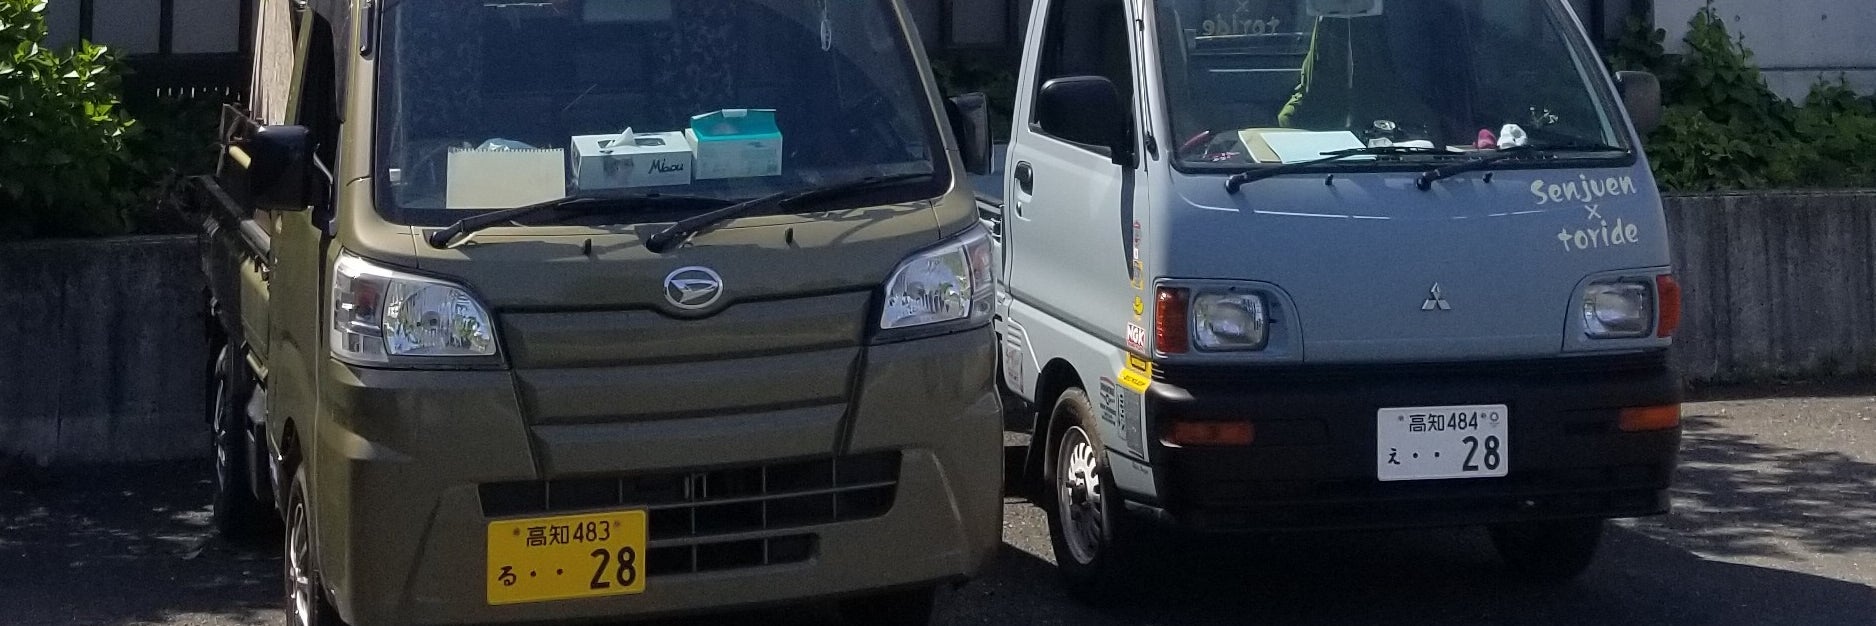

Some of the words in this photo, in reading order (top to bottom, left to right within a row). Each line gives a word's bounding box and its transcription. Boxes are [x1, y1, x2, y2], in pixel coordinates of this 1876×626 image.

[1530, 174, 1637, 205] Senjuen
[1558, 218, 1639, 251] toride
[1126, 323, 1146, 347] NGK
